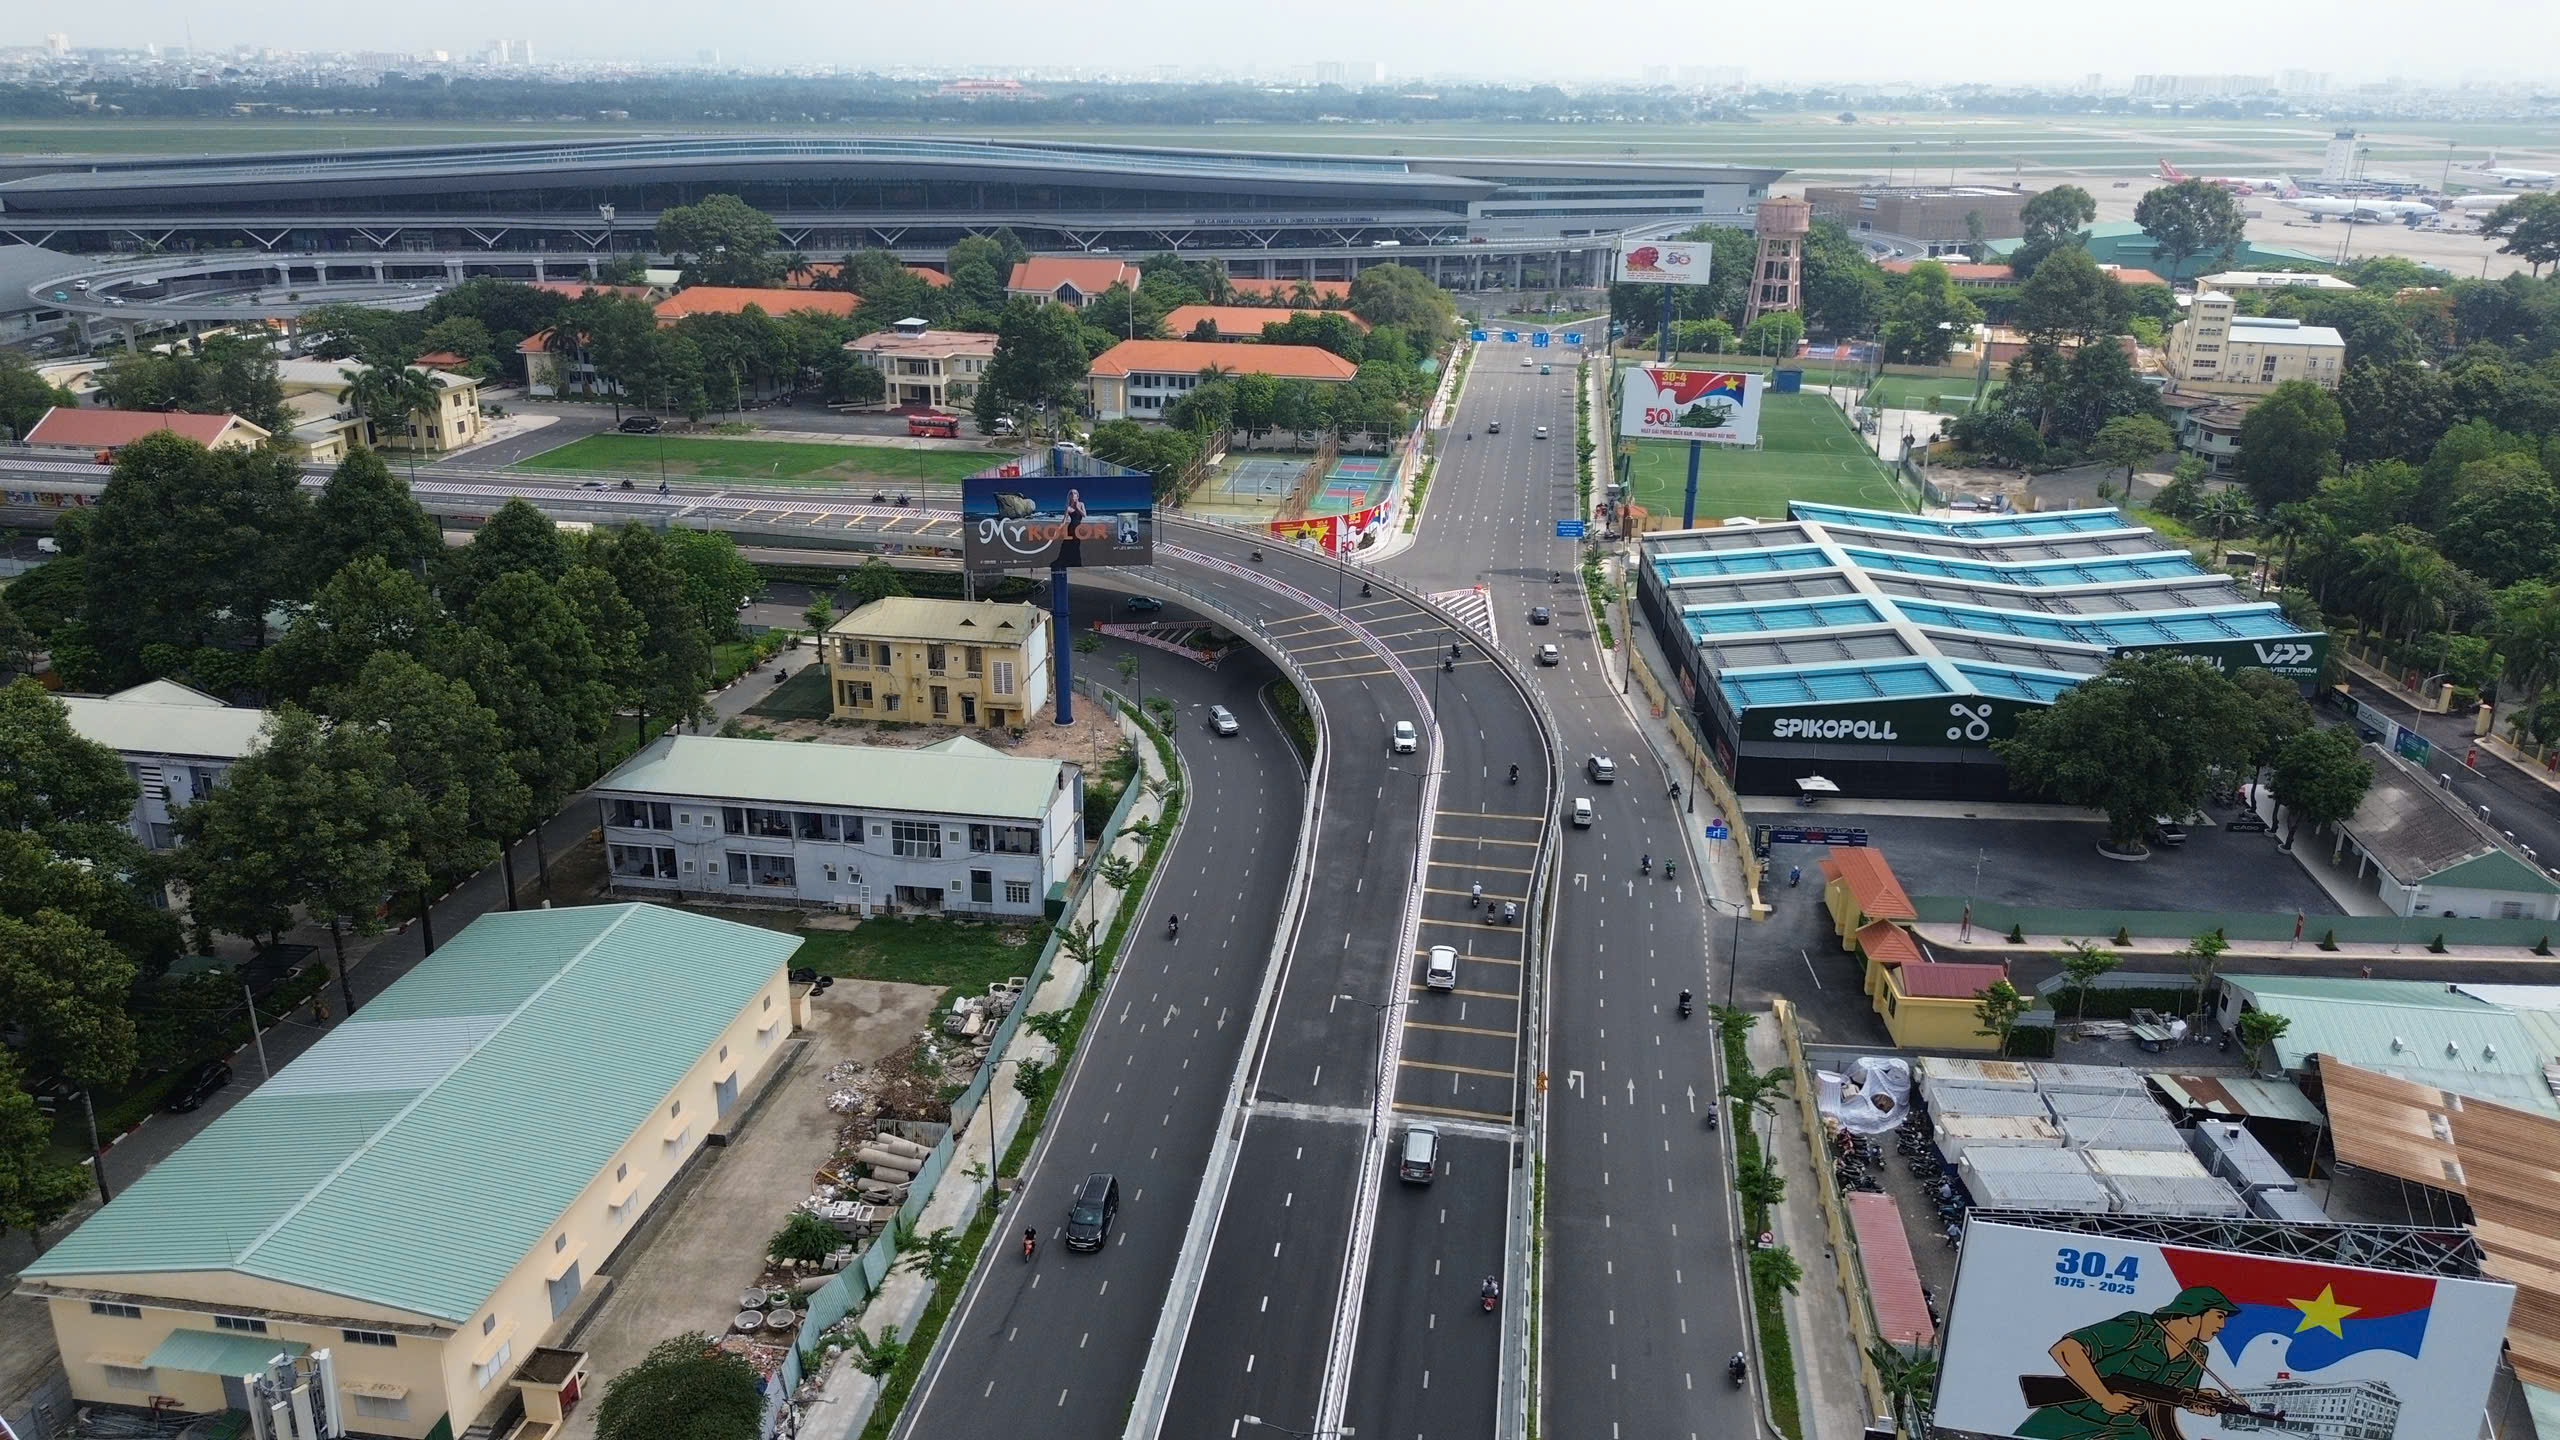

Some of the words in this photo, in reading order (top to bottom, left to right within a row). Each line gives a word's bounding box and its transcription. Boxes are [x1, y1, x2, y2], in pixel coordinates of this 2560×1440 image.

[1644, 408, 1672, 426] 50
[1772, 718, 1898, 740] SPIKOPOLL
[2055, 1248, 2139, 1281] 30.4
[2054, 1276, 2085, 1288] 1975
[2098, 1281, 2136, 1295] 2025
